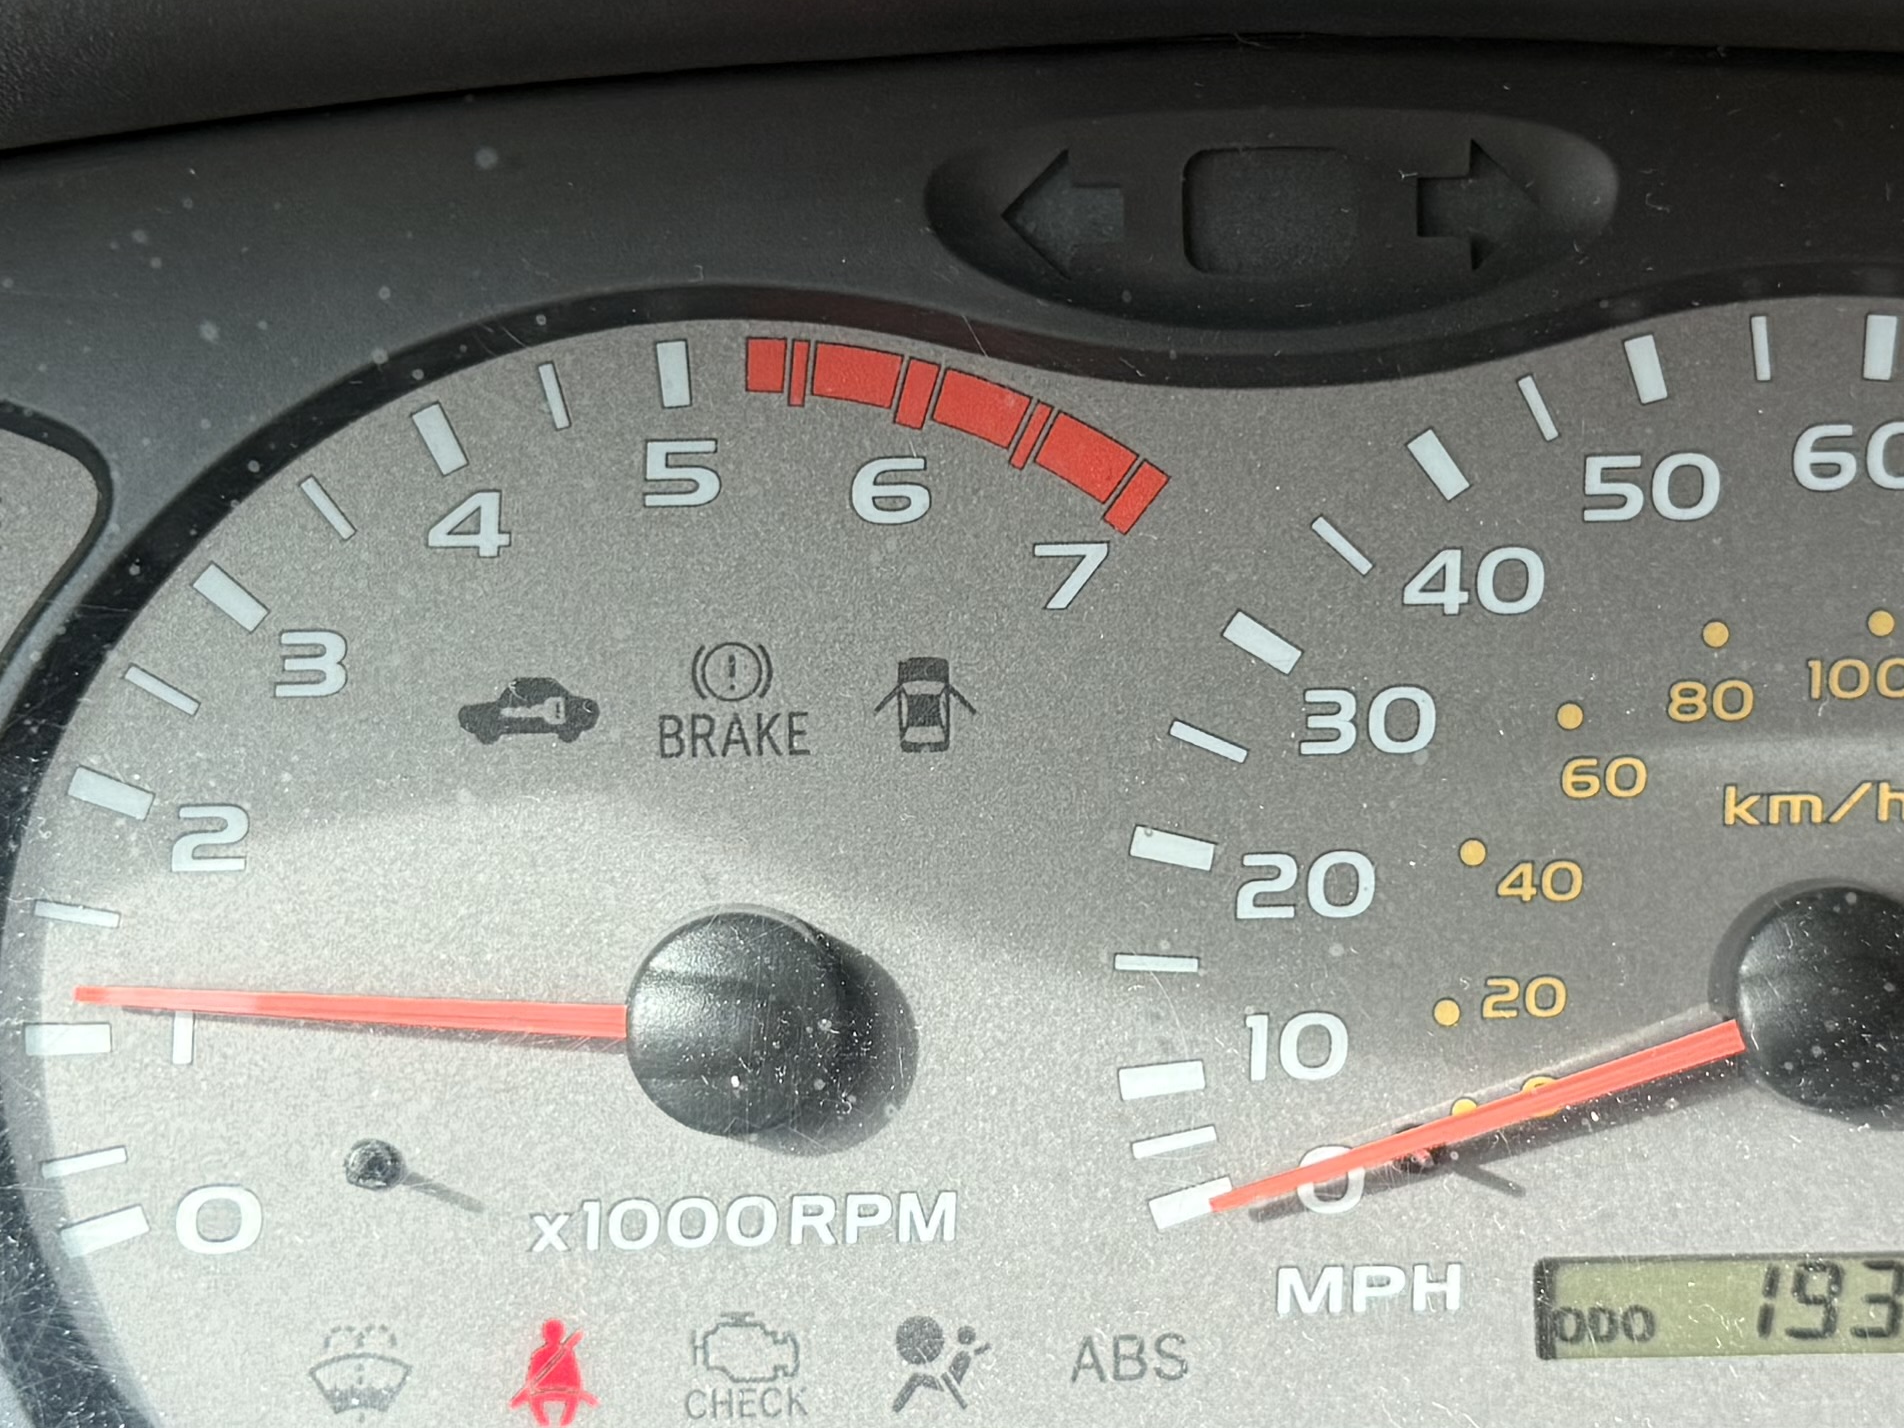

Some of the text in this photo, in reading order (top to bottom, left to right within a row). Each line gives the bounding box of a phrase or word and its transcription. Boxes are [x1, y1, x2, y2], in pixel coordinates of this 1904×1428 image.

[644, 439, 721, 507] 5
[851, 456, 931, 524] 6
[1584, 452, 1720, 521] 50
[427, 490, 511, 557] 4
[1033, 541, 1109, 609] 7
[1403, 546, 1545, 615] 40
[274, 629, 348, 698] 3
[1300, 685, 1436, 755] 30
[1667, 679, 1755, 722] 80
[658, 712, 811, 759] BRAKE
[1561, 756, 1647, 799] 60
[171, 804, 250, 872] 2
[1236, 850, 1375, 919] 20
[1497, 860, 1584, 901] 40
[1482, 976, 1568, 1019] 20
[1245, 1011, 1349, 1080] 10
[176, 1184, 263, 1254] 0
[1277, 1264, 1462, 1315] MPH
[1071, 1333, 1188, 1383] ABS
[1552, 1305, 1655, 1344] ODO
[685, 1387, 807, 1421] CHECK
